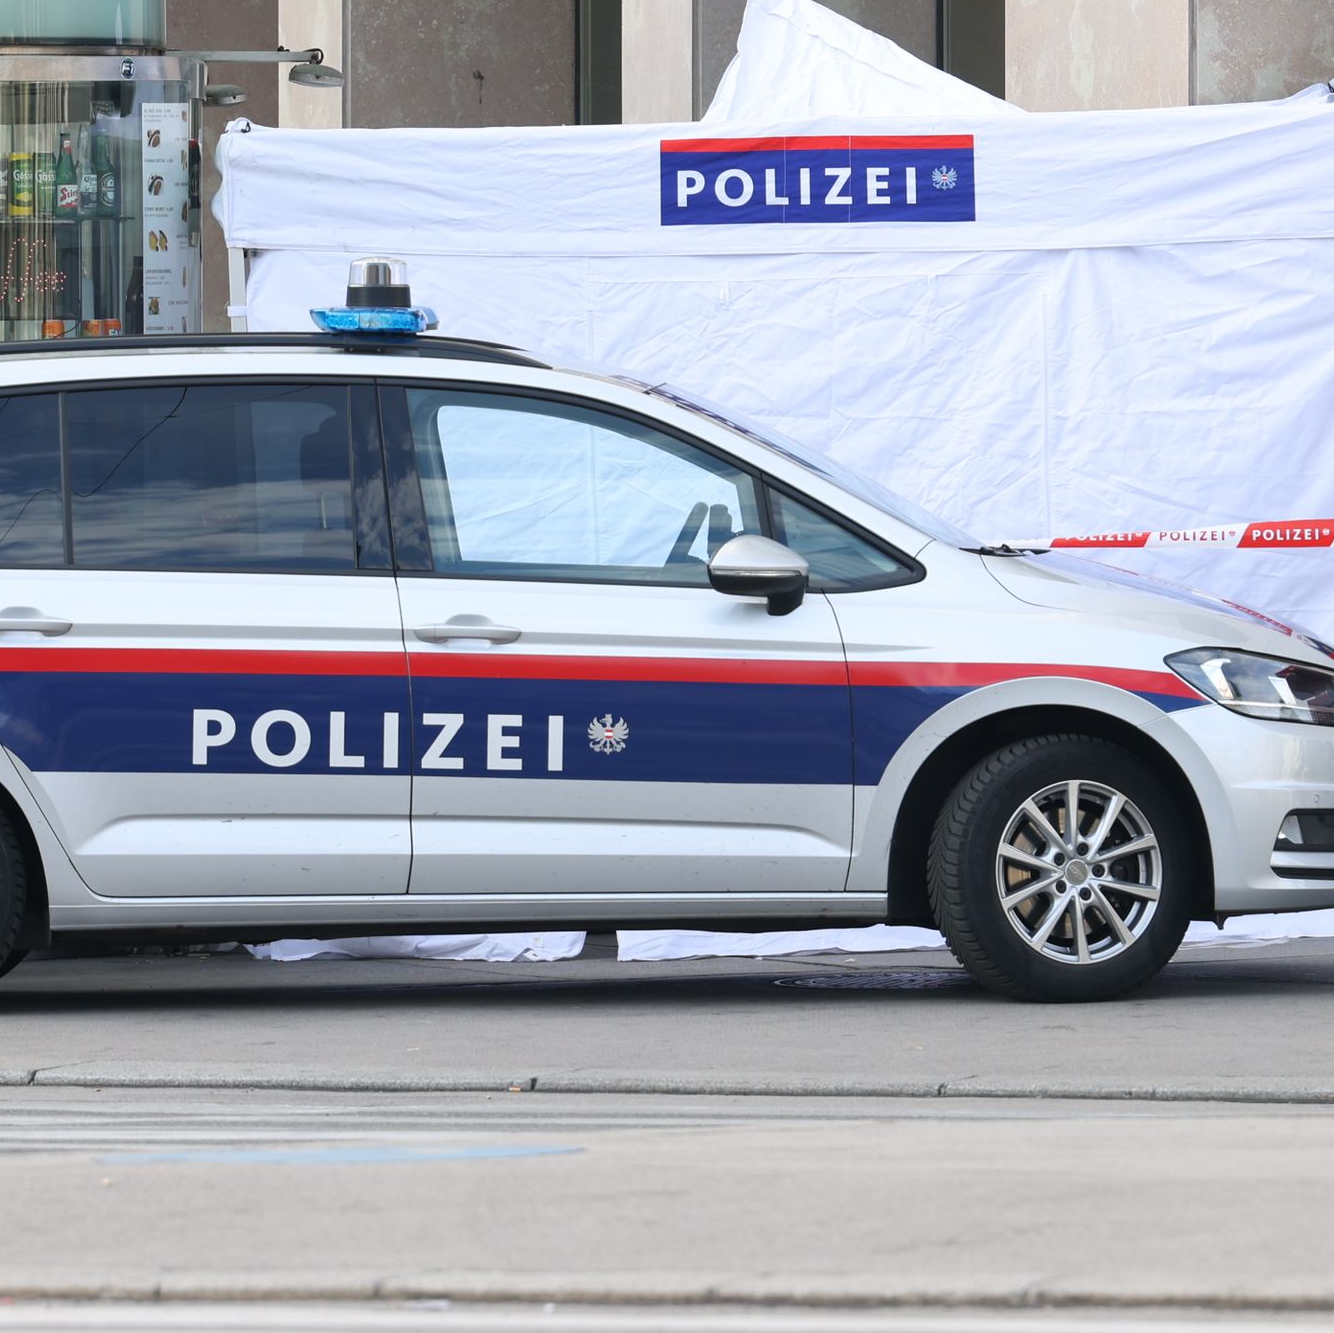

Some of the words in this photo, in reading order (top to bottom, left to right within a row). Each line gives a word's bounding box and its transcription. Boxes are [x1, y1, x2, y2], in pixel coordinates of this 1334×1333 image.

[676, 166, 917, 208] POLIZEI
[1159, 531, 1225, 541] POLIZEI
[1252, 528, 1319, 541] POLIZEI
[192, 709, 565, 771] POLIZEI
